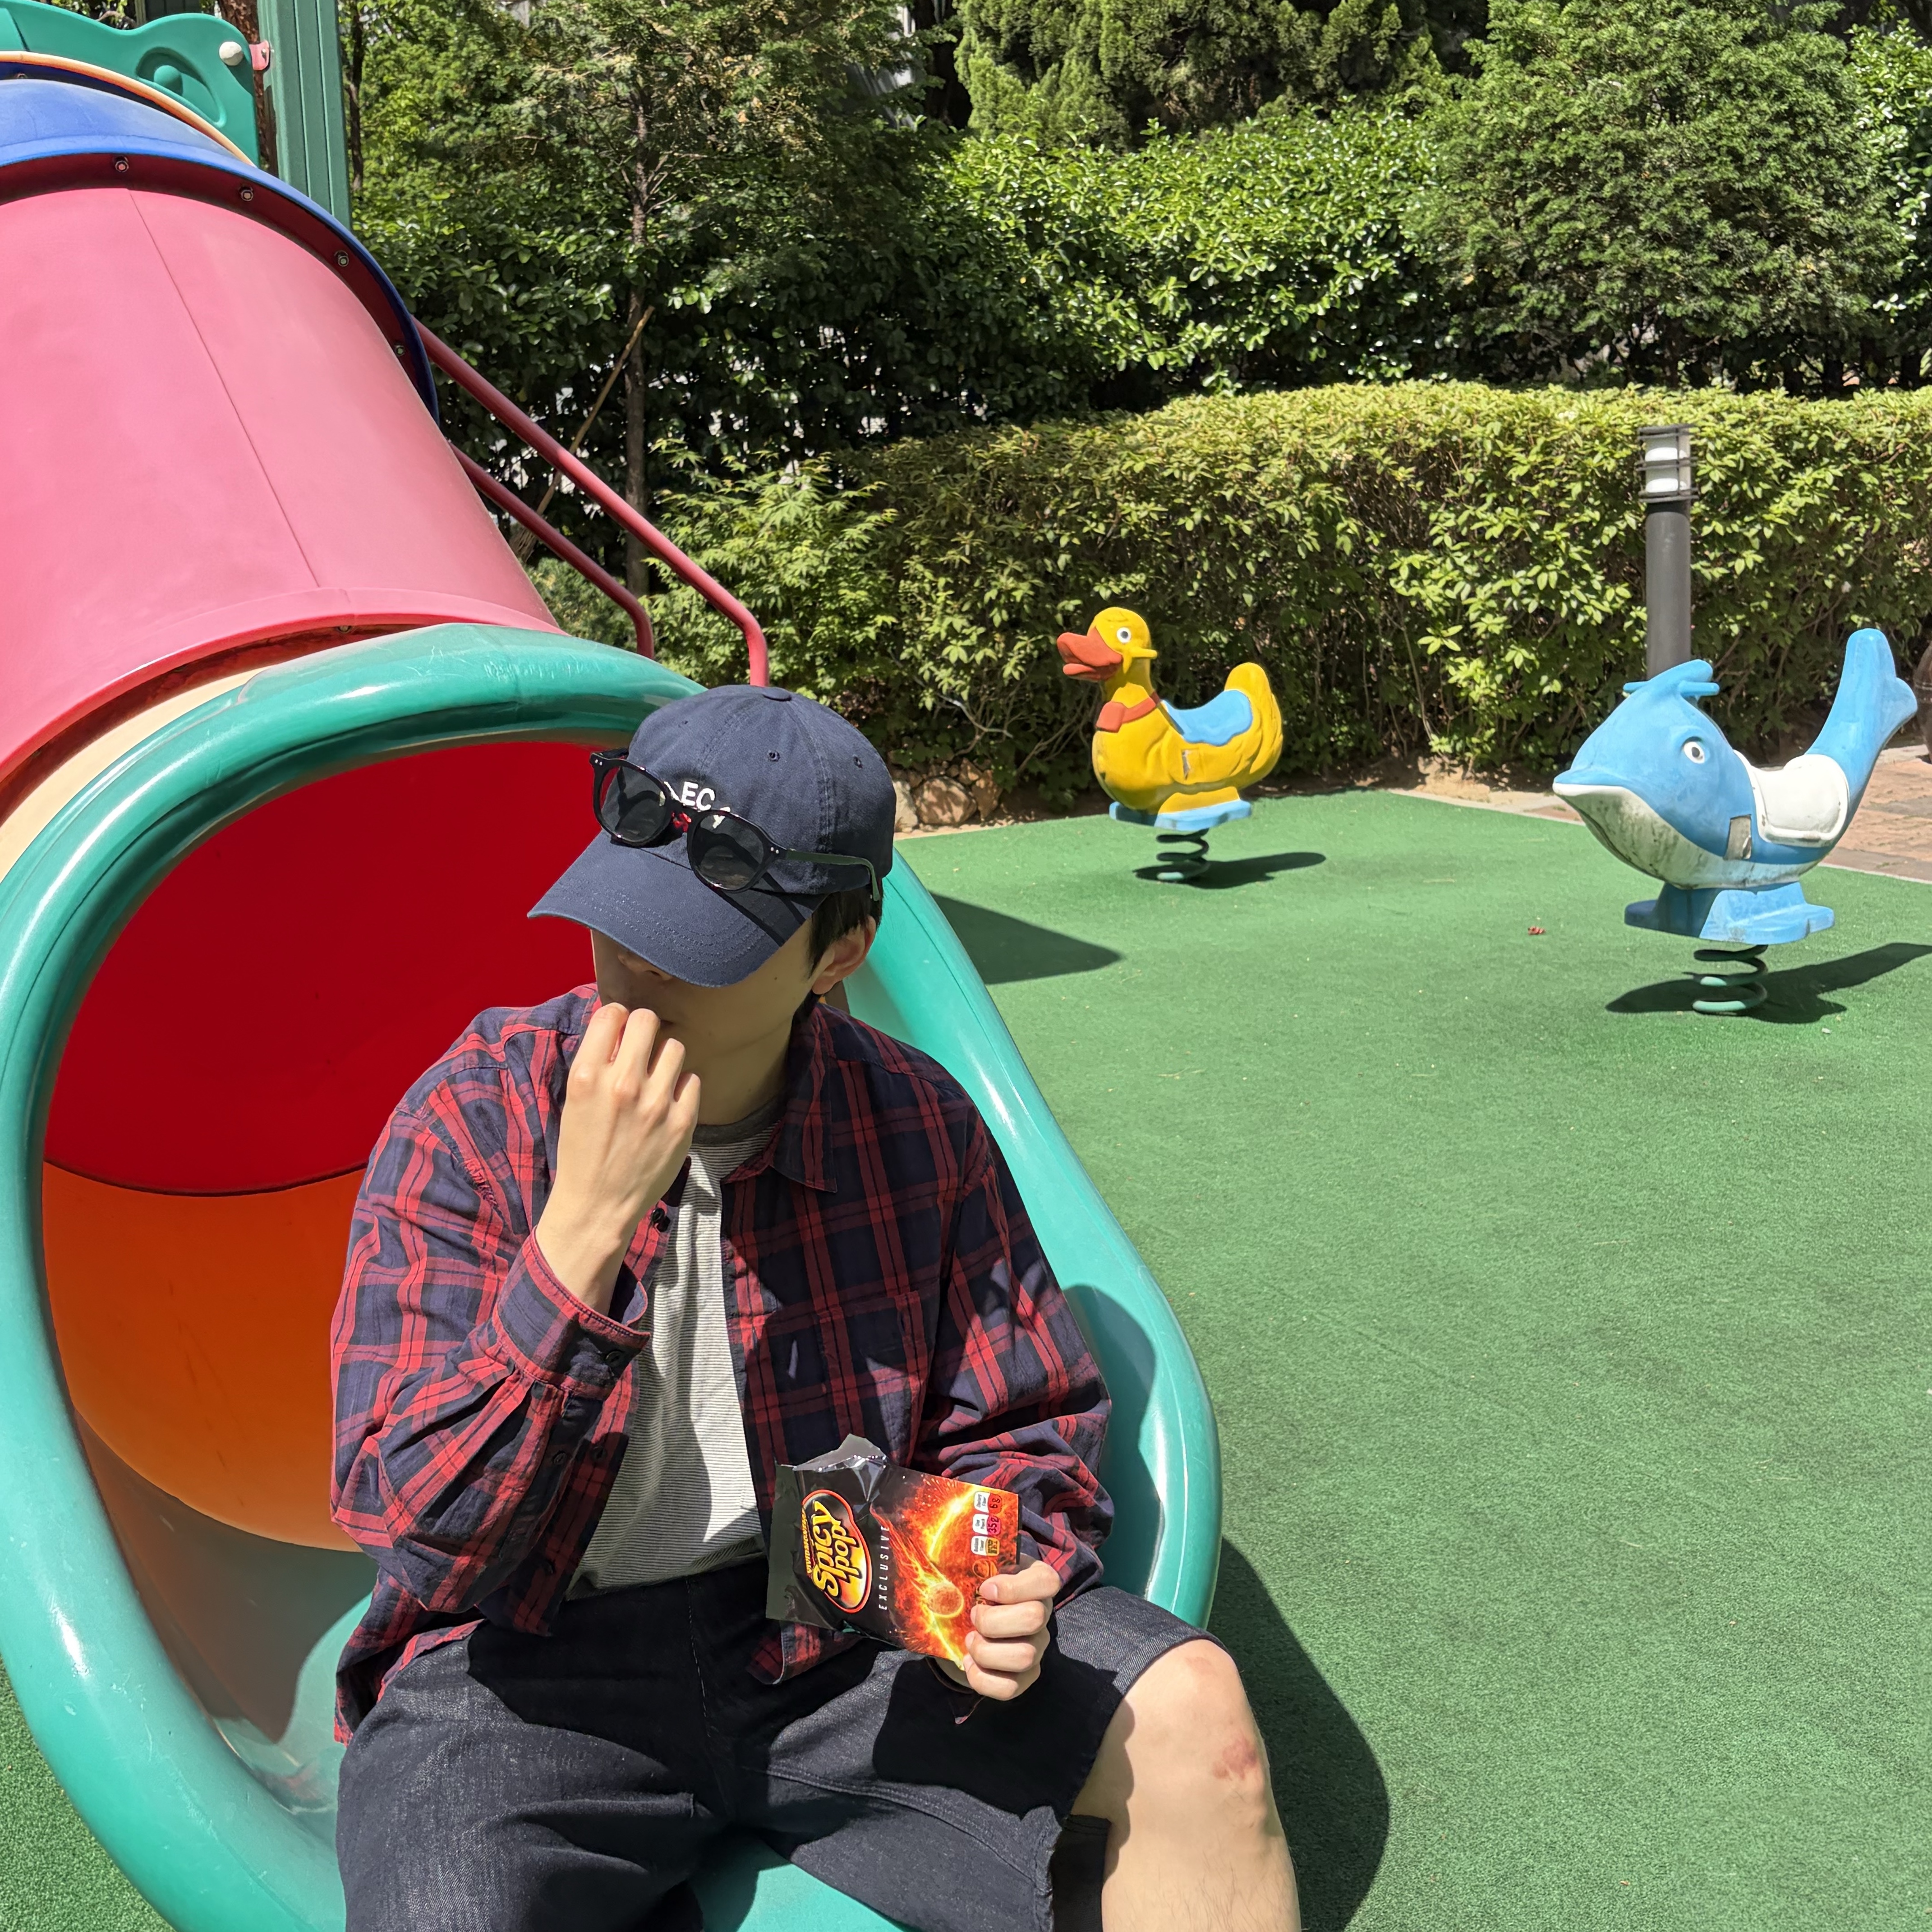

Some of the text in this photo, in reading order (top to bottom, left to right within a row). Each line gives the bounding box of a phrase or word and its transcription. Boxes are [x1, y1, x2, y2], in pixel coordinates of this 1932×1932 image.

[813, 1501, 847, 1596] Spicy
[831, 1524, 859, 1576] pop
[879, 1526, 890, 1610] EXCLUSIVE
